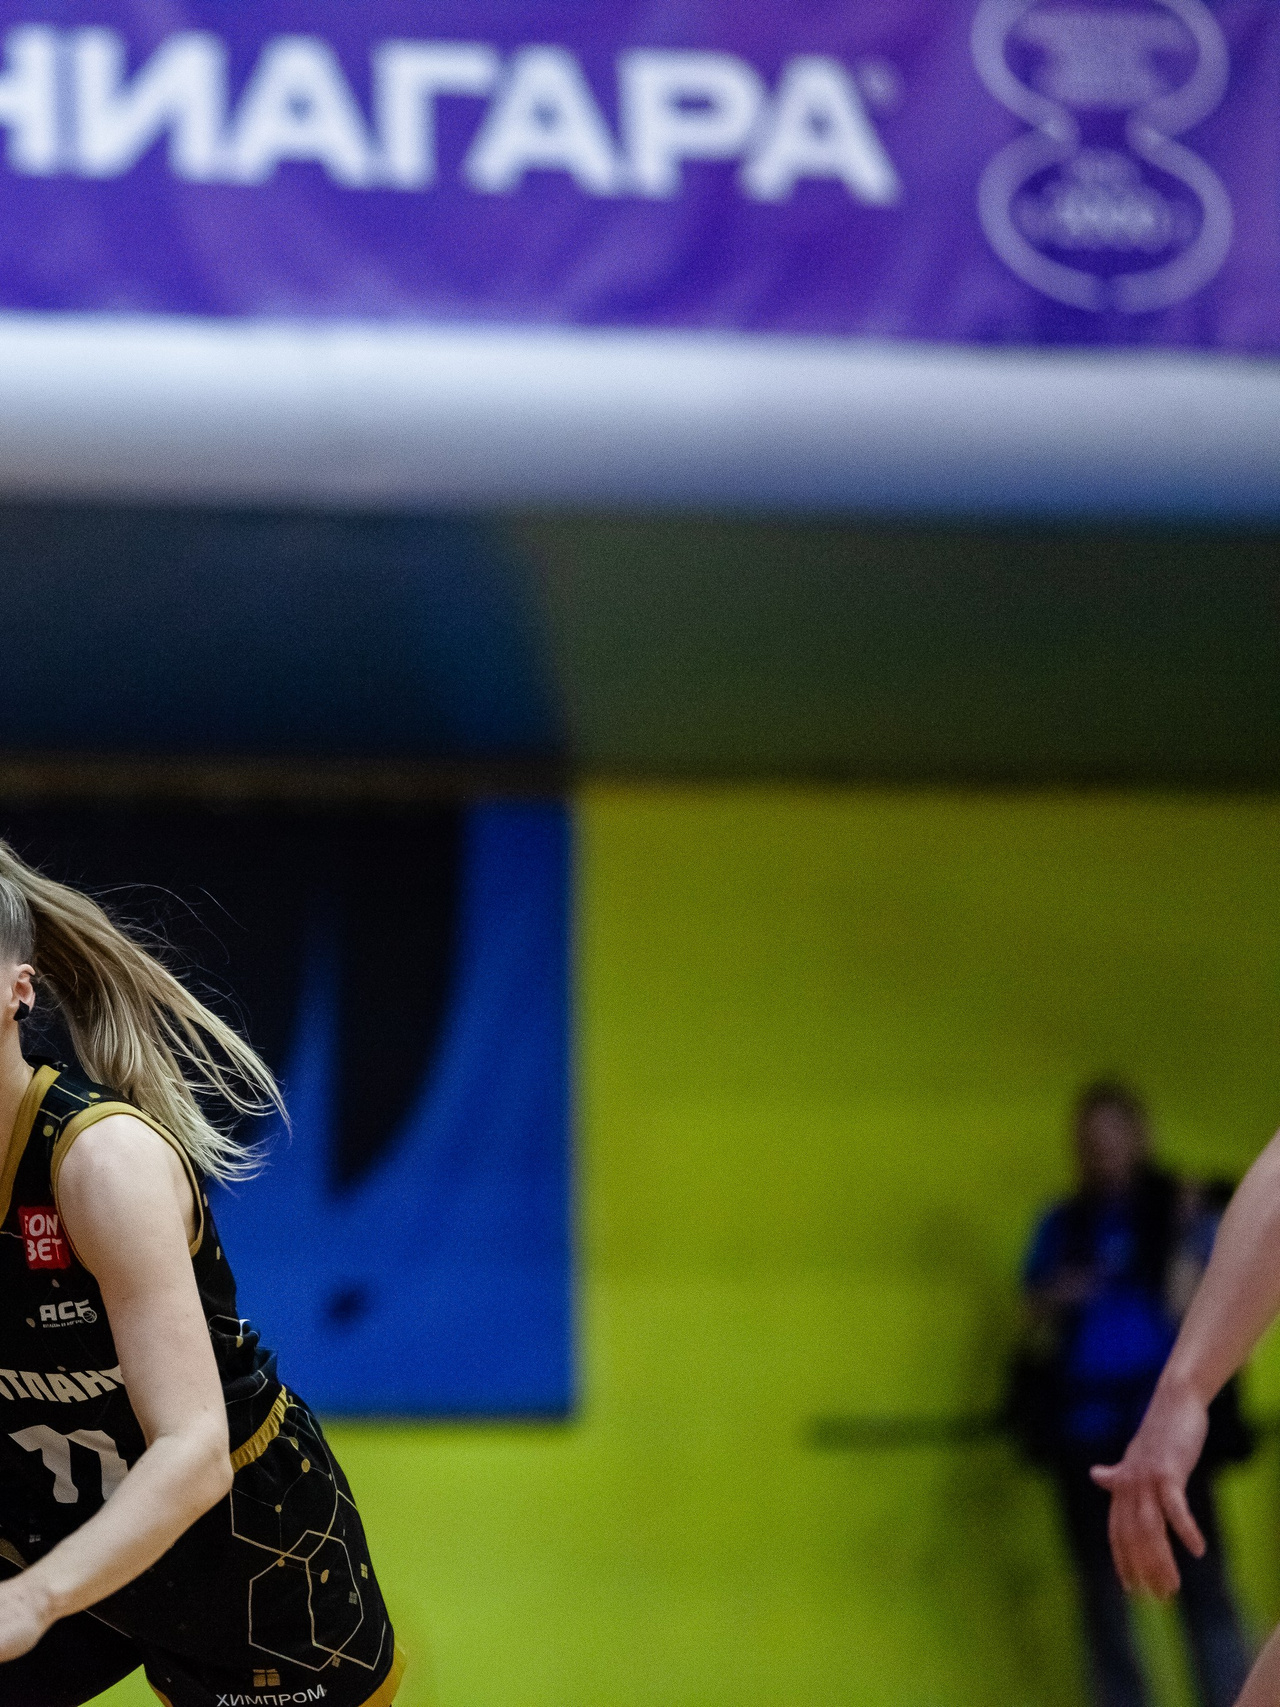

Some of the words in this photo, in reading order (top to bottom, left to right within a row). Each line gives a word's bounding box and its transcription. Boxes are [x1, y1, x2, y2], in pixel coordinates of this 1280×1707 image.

[26, 1237, 63, 1262] BET
[8, 1424, 129, 1504] 77
[216, 1684, 326, 1707] ХИМПРОМ
